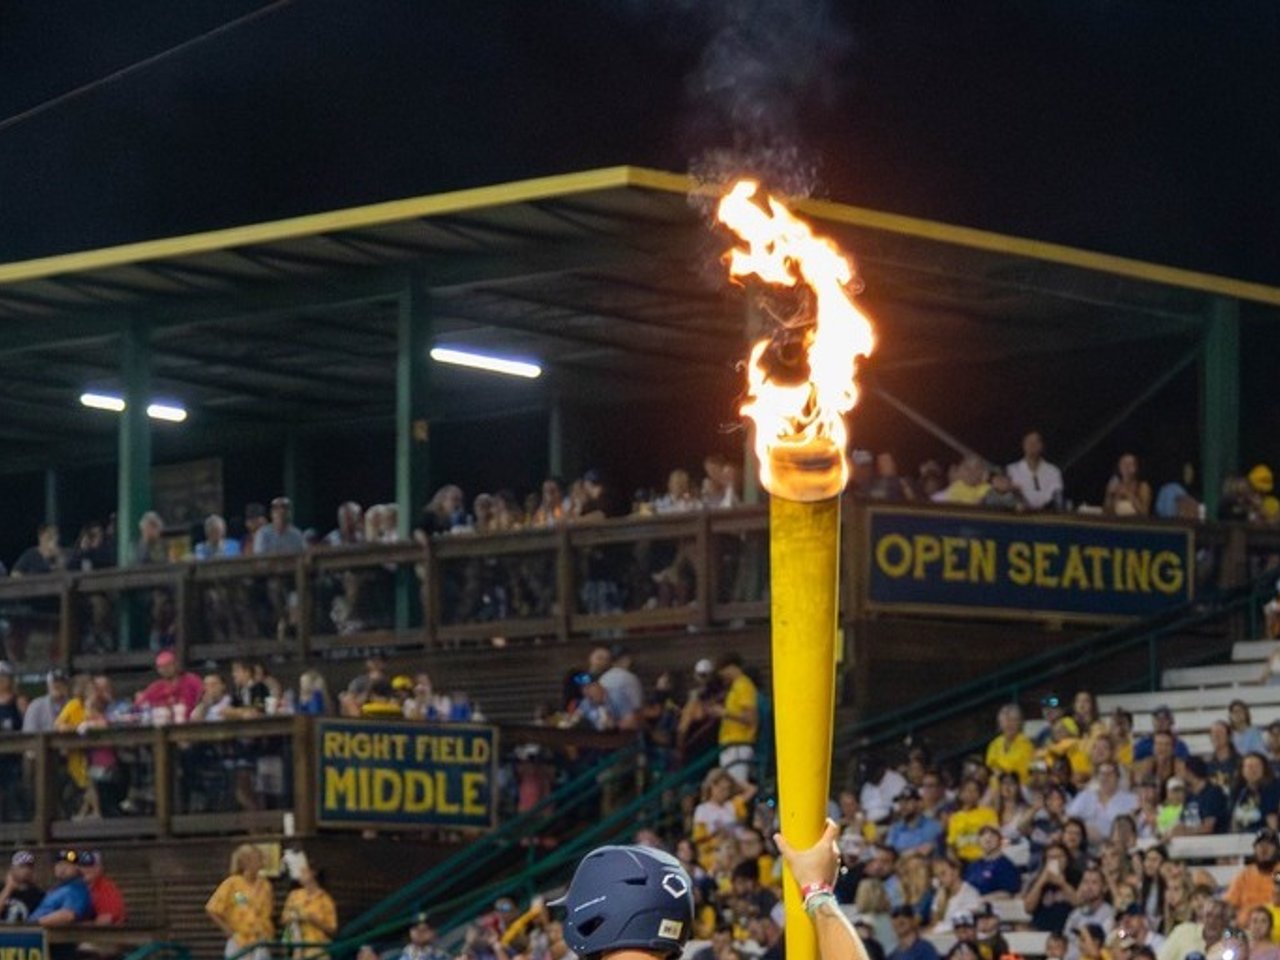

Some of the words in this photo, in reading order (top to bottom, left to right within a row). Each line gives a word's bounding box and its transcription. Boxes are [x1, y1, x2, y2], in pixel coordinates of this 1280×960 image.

[875, 533, 997, 583] OPEN
[1007, 541, 1184, 594] SEATING
[324, 730, 409, 761] RIGHT
[415, 735, 490, 765] FIELD
[324, 765, 487, 815] MIDDLE
